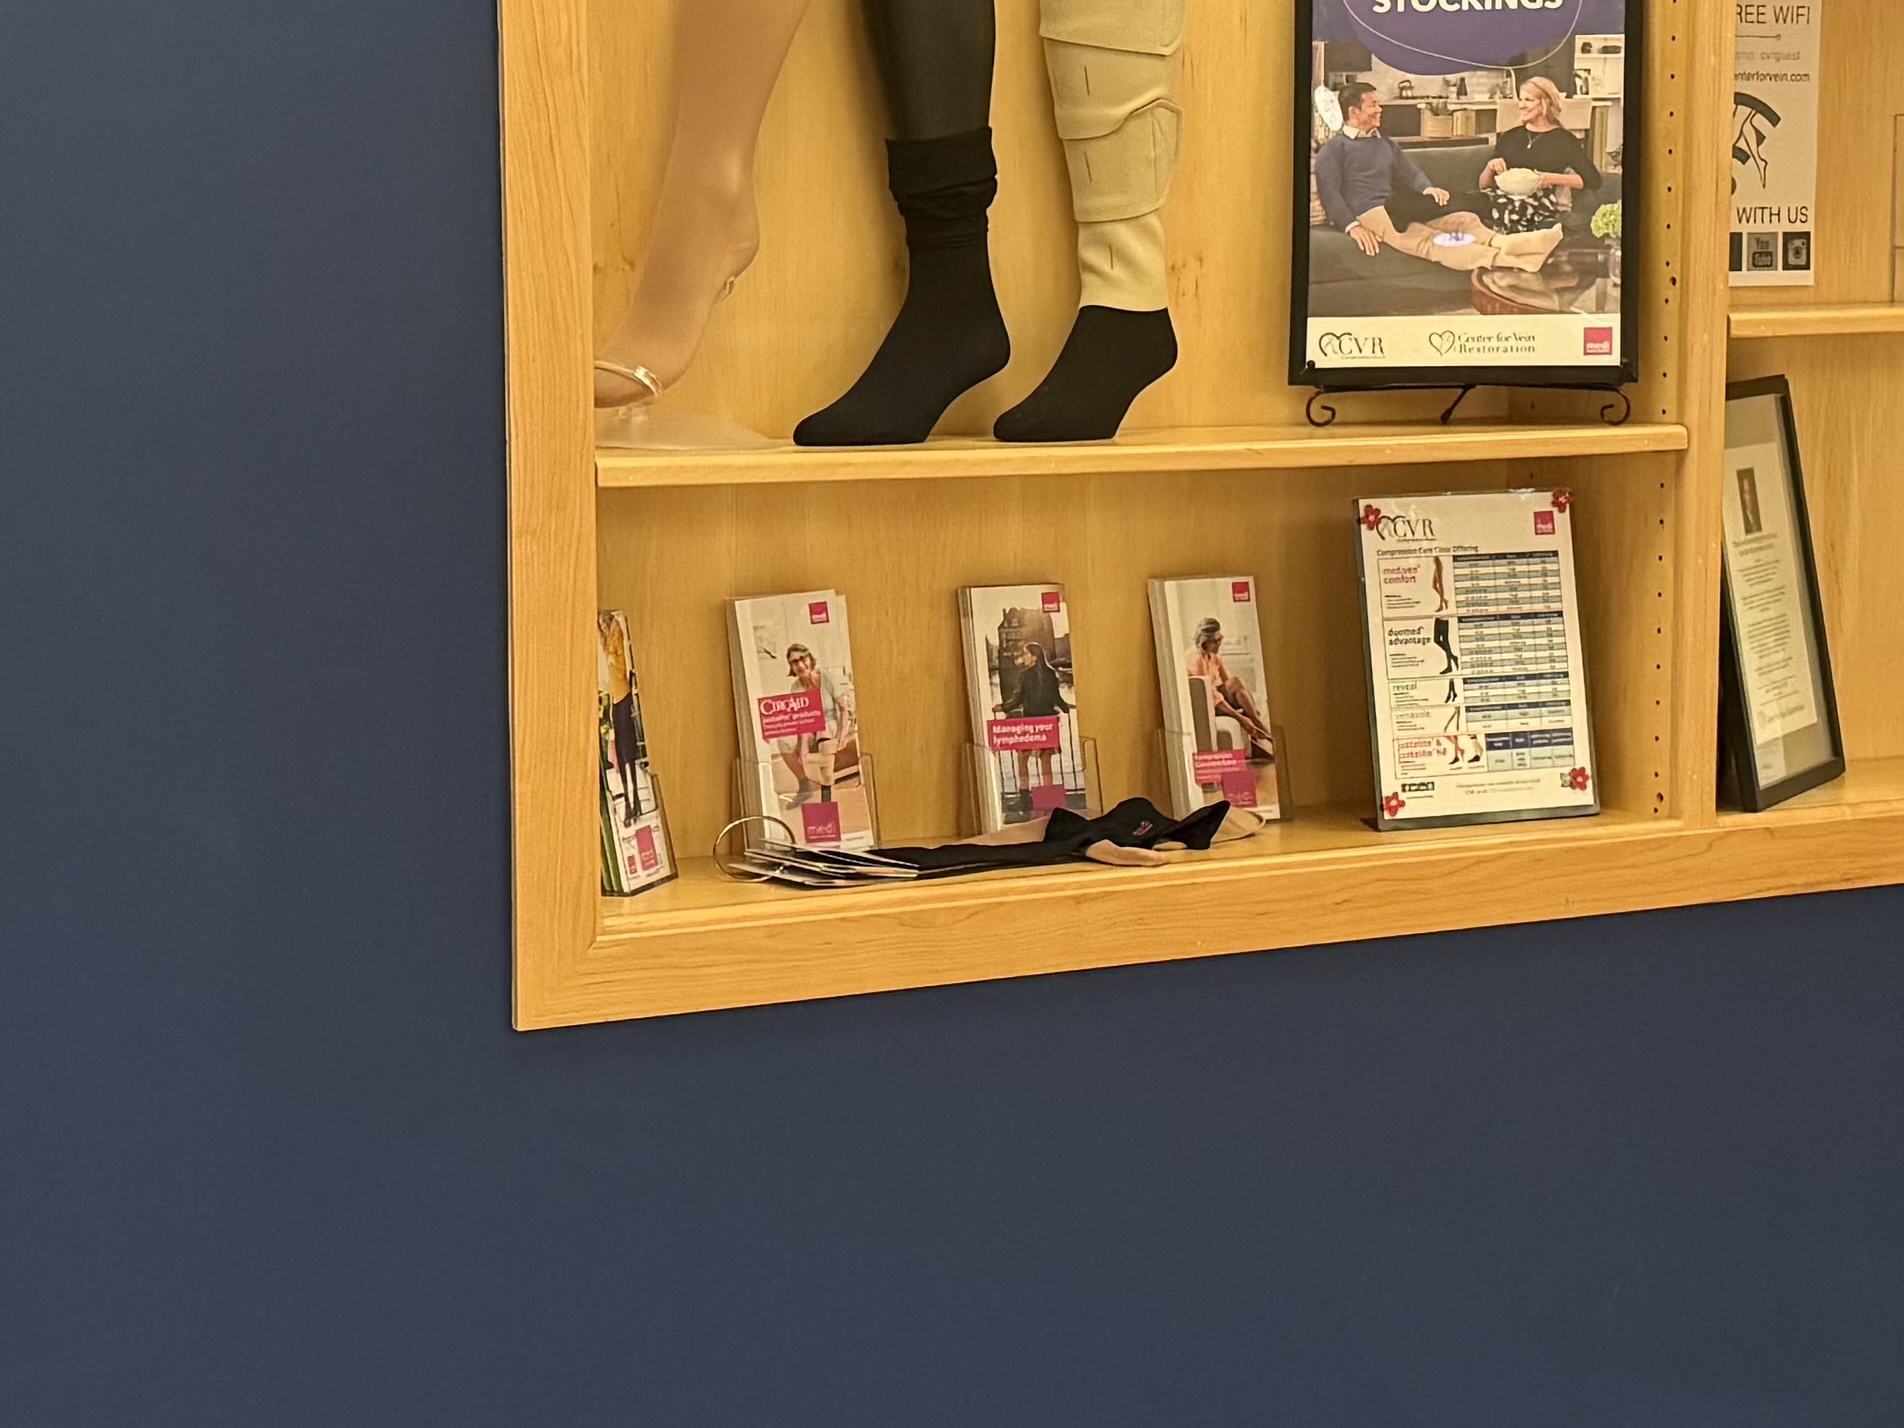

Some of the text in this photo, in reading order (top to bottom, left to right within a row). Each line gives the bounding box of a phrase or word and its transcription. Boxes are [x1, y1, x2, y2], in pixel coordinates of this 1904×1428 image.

[1736, 4, 1811, 25] REE WIFI
[1736, 206, 1809, 224] WITH US
